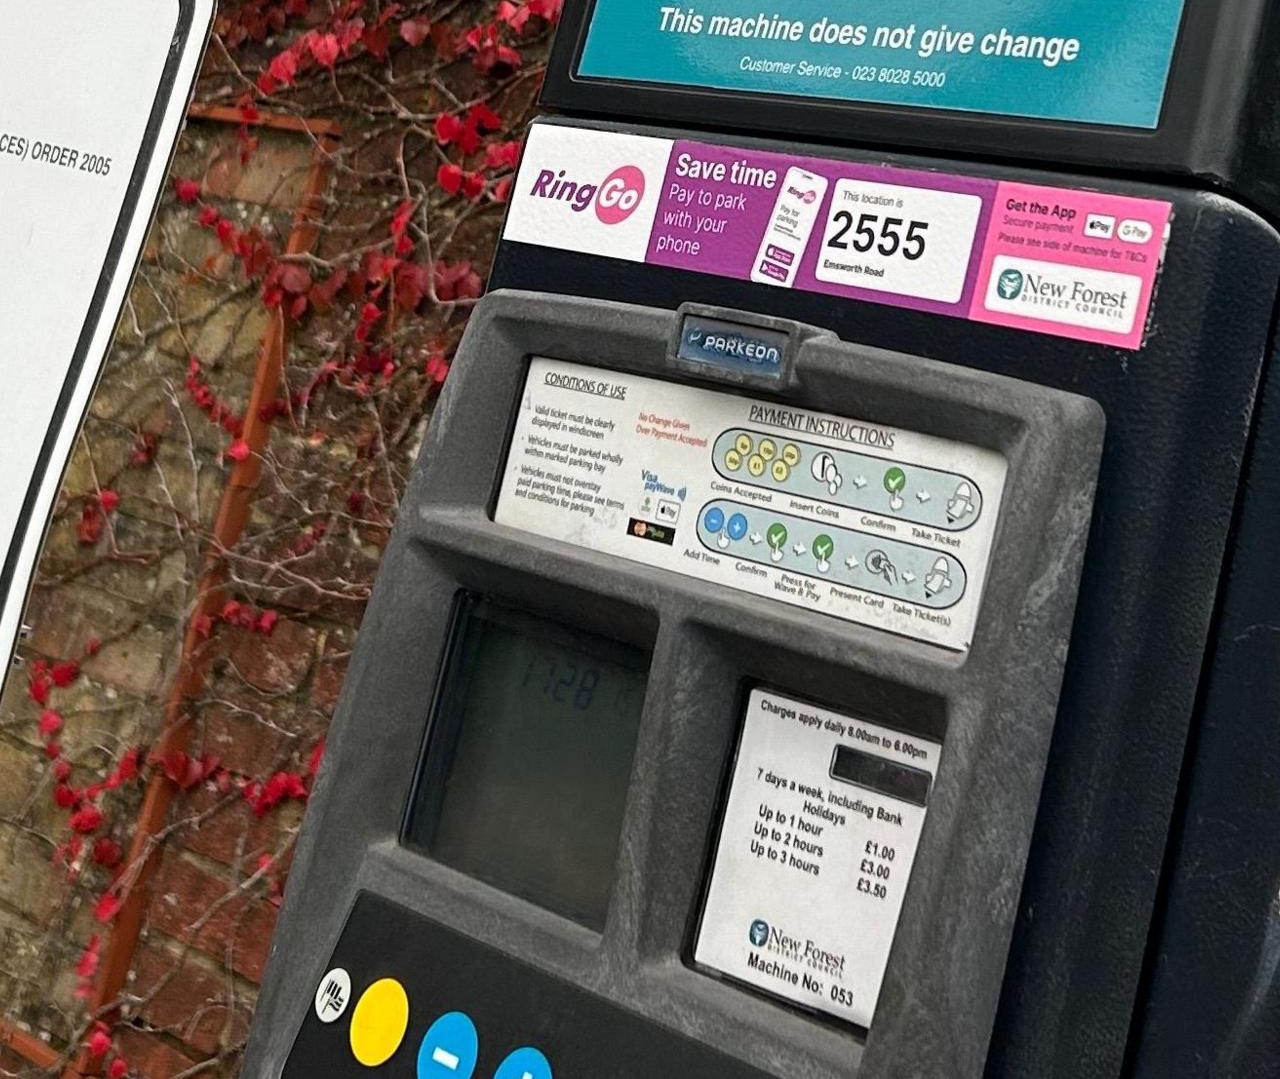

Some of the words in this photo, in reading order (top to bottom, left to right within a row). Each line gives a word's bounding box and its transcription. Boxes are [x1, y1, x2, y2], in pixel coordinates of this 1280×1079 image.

[660, 7, 703, 33] This
[708, 13, 803, 40] machine
[809, 17, 867, 45] does
[872, 24, 915, 48] not
[918, 25, 974, 57] give
[980, 28, 1079, 66] change
[740, 56, 796, 73] Customer
[796, 61, 841, 78] Service
[852, 66, 876, 81] 023
[878, 68, 910, 84] 8028
[912, 71, 945, 86] 5000
[676, 153, 725, 180] Save
[730, 160, 776, 188] time
[530, 169, 638, 212] RingGo
[669, 183, 694, 206] Pay
[698, 189, 711, 205] to
[714, 193, 746, 210] park
[843, 190, 859, 201] This
[861, 193, 894, 206] location
[664, 210, 691, 227] with
[694, 216, 727, 233] your
[1006, 198, 1027, 212] Get
[1029, 202, 1048, 215] the
[1050, 205, 1076, 221] App
[656, 234, 699, 254] phone
[827, 210, 928, 260] 2555
[823, 259, 862, 273] Emsworth
[863, 266, 884, 277] Road
[1024, 274, 1066, 297] New
[1070, 281, 1126, 308] Forest
[749, 405, 804, 428] PAYMENT
[805, 415, 895, 447] INSTRUCTIONS
[759, 803, 773, 820] Up
[775, 810, 786, 824] to
[790, 814, 794, 827] 1
[797, 816, 823, 836] hour
[864, 840, 894, 861] £1.00
[754, 821, 768, 838] Up
[771, 828, 781, 841] to
[783, 832, 790, 846] 2
[793, 834, 823, 856] hours
[860, 858, 889, 879] £3.00
[750, 839, 764, 856] Up
[767, 846, 777, 860] to
[780, 850, 786, 863] 3
[789, 853, 819, 875] hours
[856, 877, 886, 898] £3.50
[747, 951, 798, 985] Machine
[802, 972, 822, 995] No:
[830, 985, 853, 1007] 053
